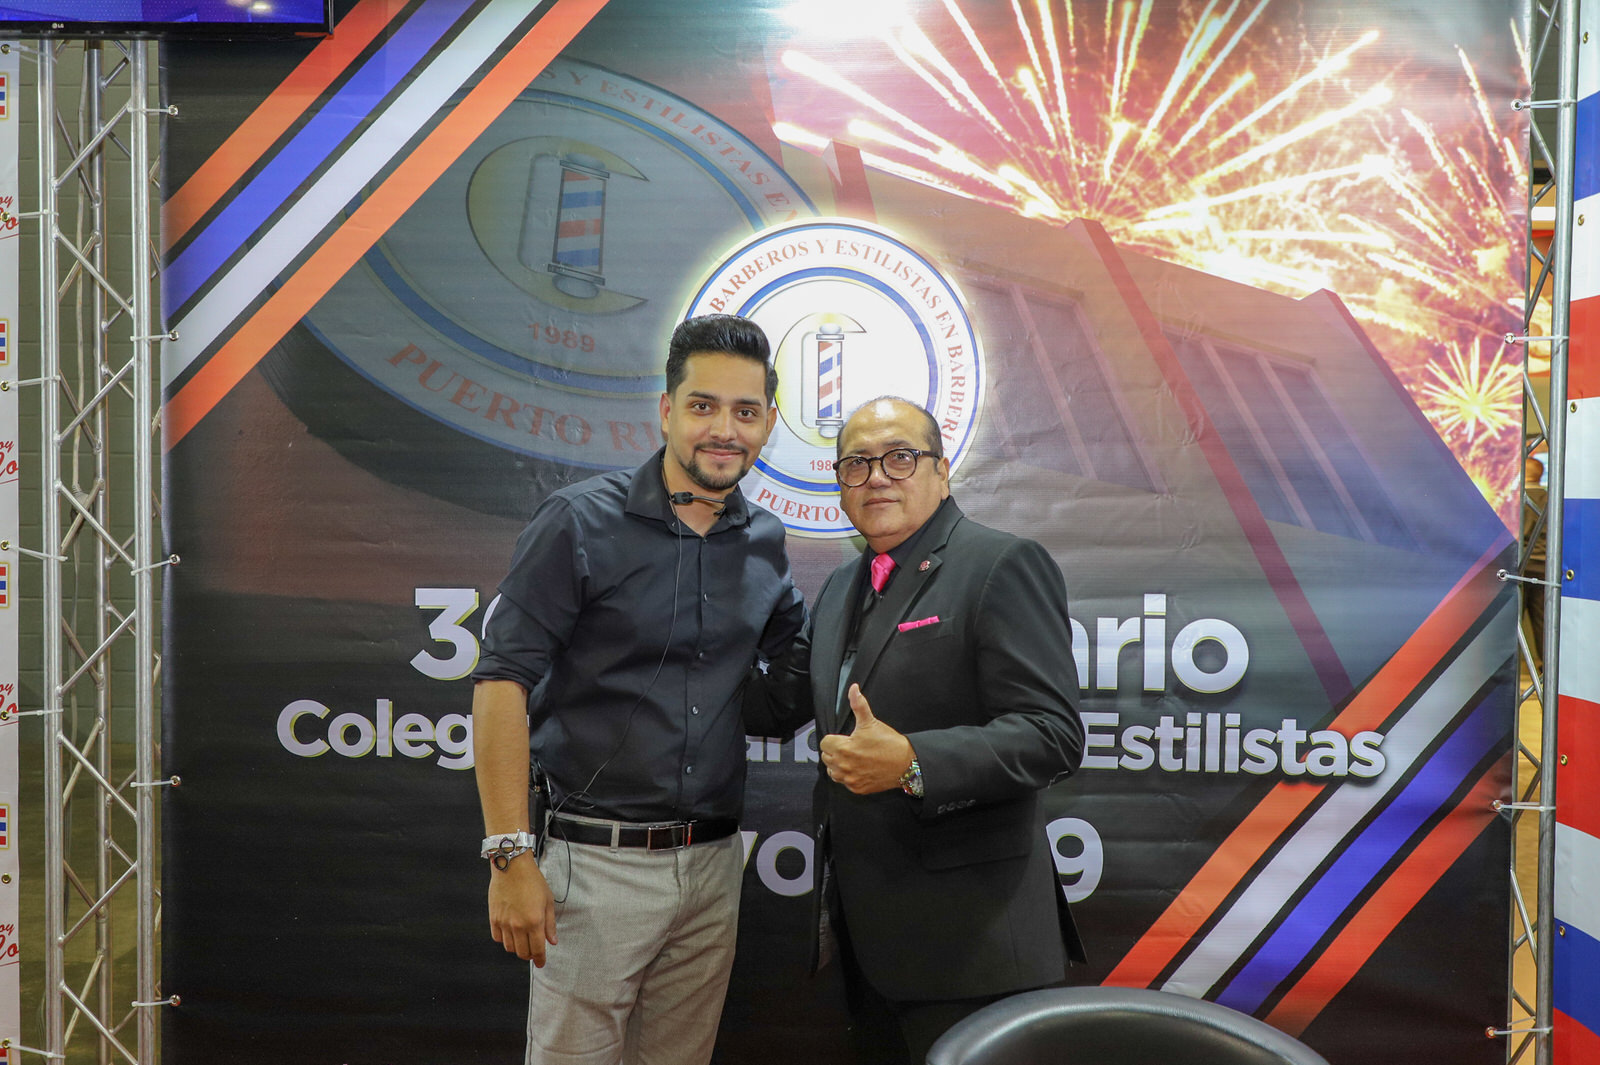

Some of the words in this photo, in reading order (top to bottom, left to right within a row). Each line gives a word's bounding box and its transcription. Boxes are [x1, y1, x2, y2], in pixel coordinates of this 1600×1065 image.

[569, 71, 589, 86] Y
[600, 80, 770, 185] ESTILISTAS
[709, 241, 809, 312] BARBEROS
[816, 239, 831, 254] Y
[836, 239, 941, 309] ESTILISTAS
[528, 323, 596, 352] 1989
[936, 310, 959, 339] EN
[385, 342, 593, 447] PUERTO
[940, 344, 966, 450] BARBERÍ
[809, 459, 837, 471] 198
[756, 488, 840, 522] PUERTO
[276, 698, 477, 770] Coleg
[1079, 712, 1386, 777] Estilistas
